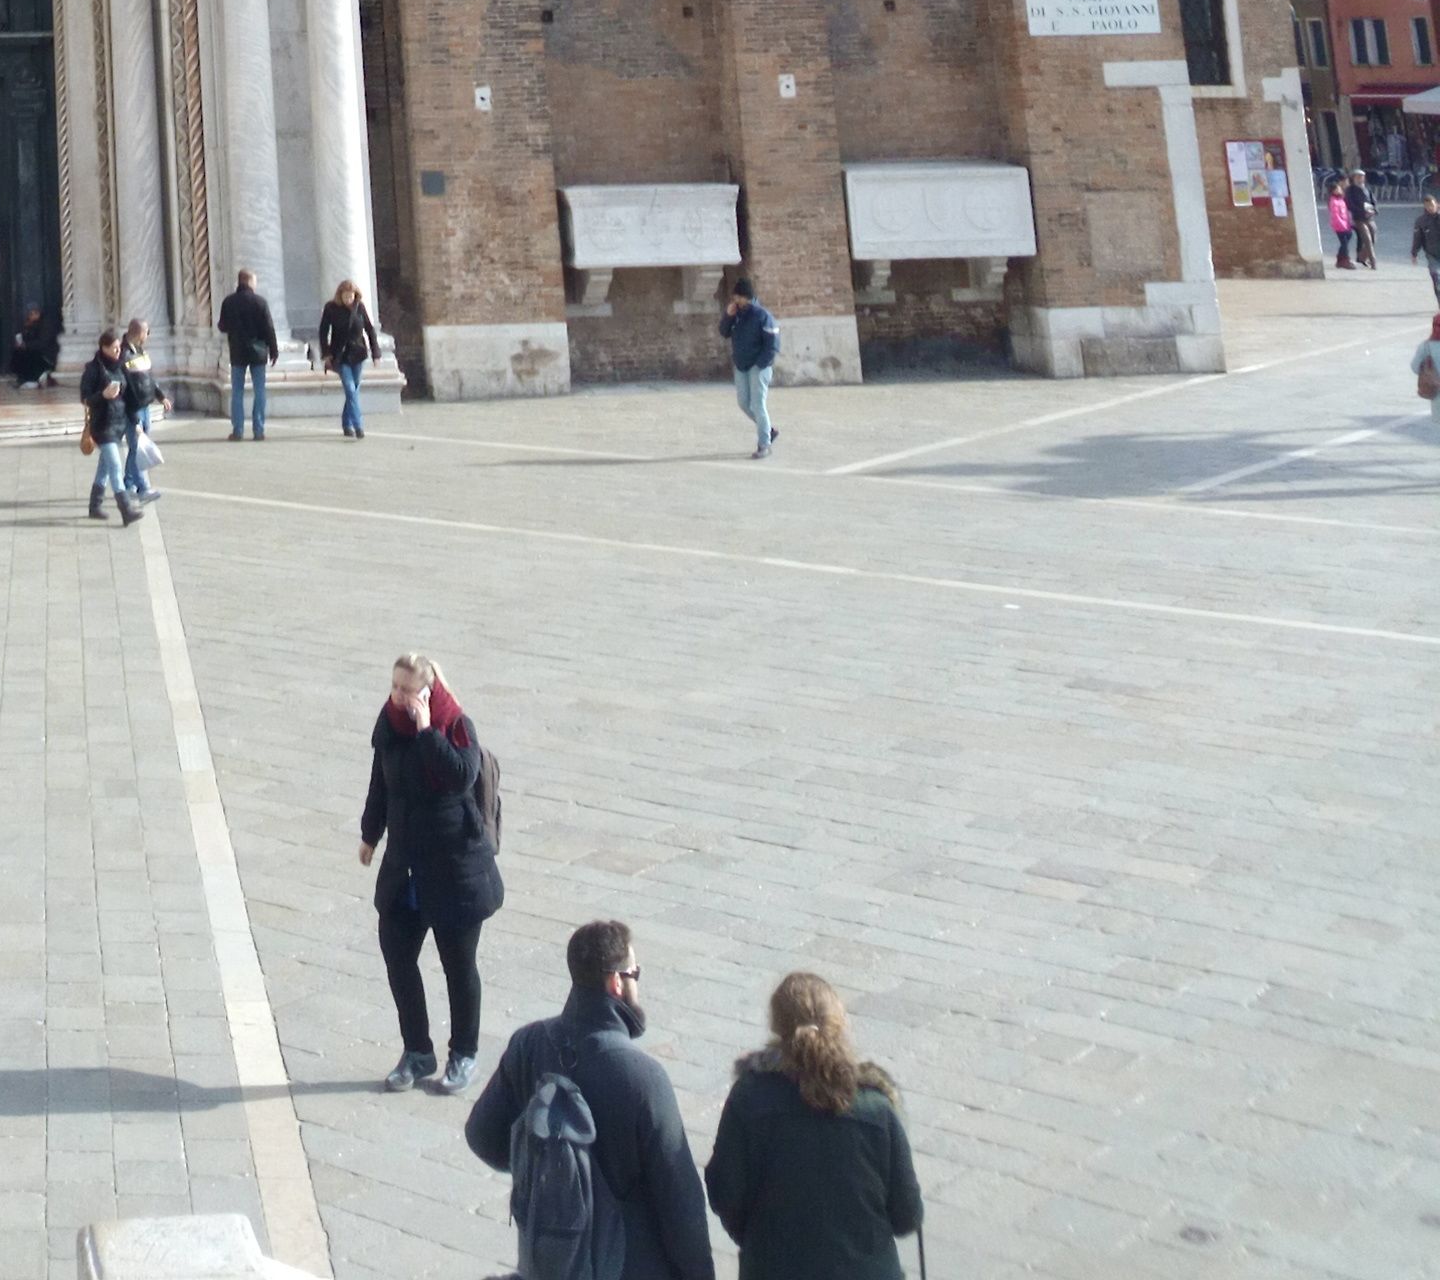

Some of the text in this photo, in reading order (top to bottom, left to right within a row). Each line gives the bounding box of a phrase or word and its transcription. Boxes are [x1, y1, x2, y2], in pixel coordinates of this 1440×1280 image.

[1031, 7, 1046, 17] DI
[1088, 4, 1156, 16] GIOVANNI
[1091, 19, 1138, 31] PAOLO
